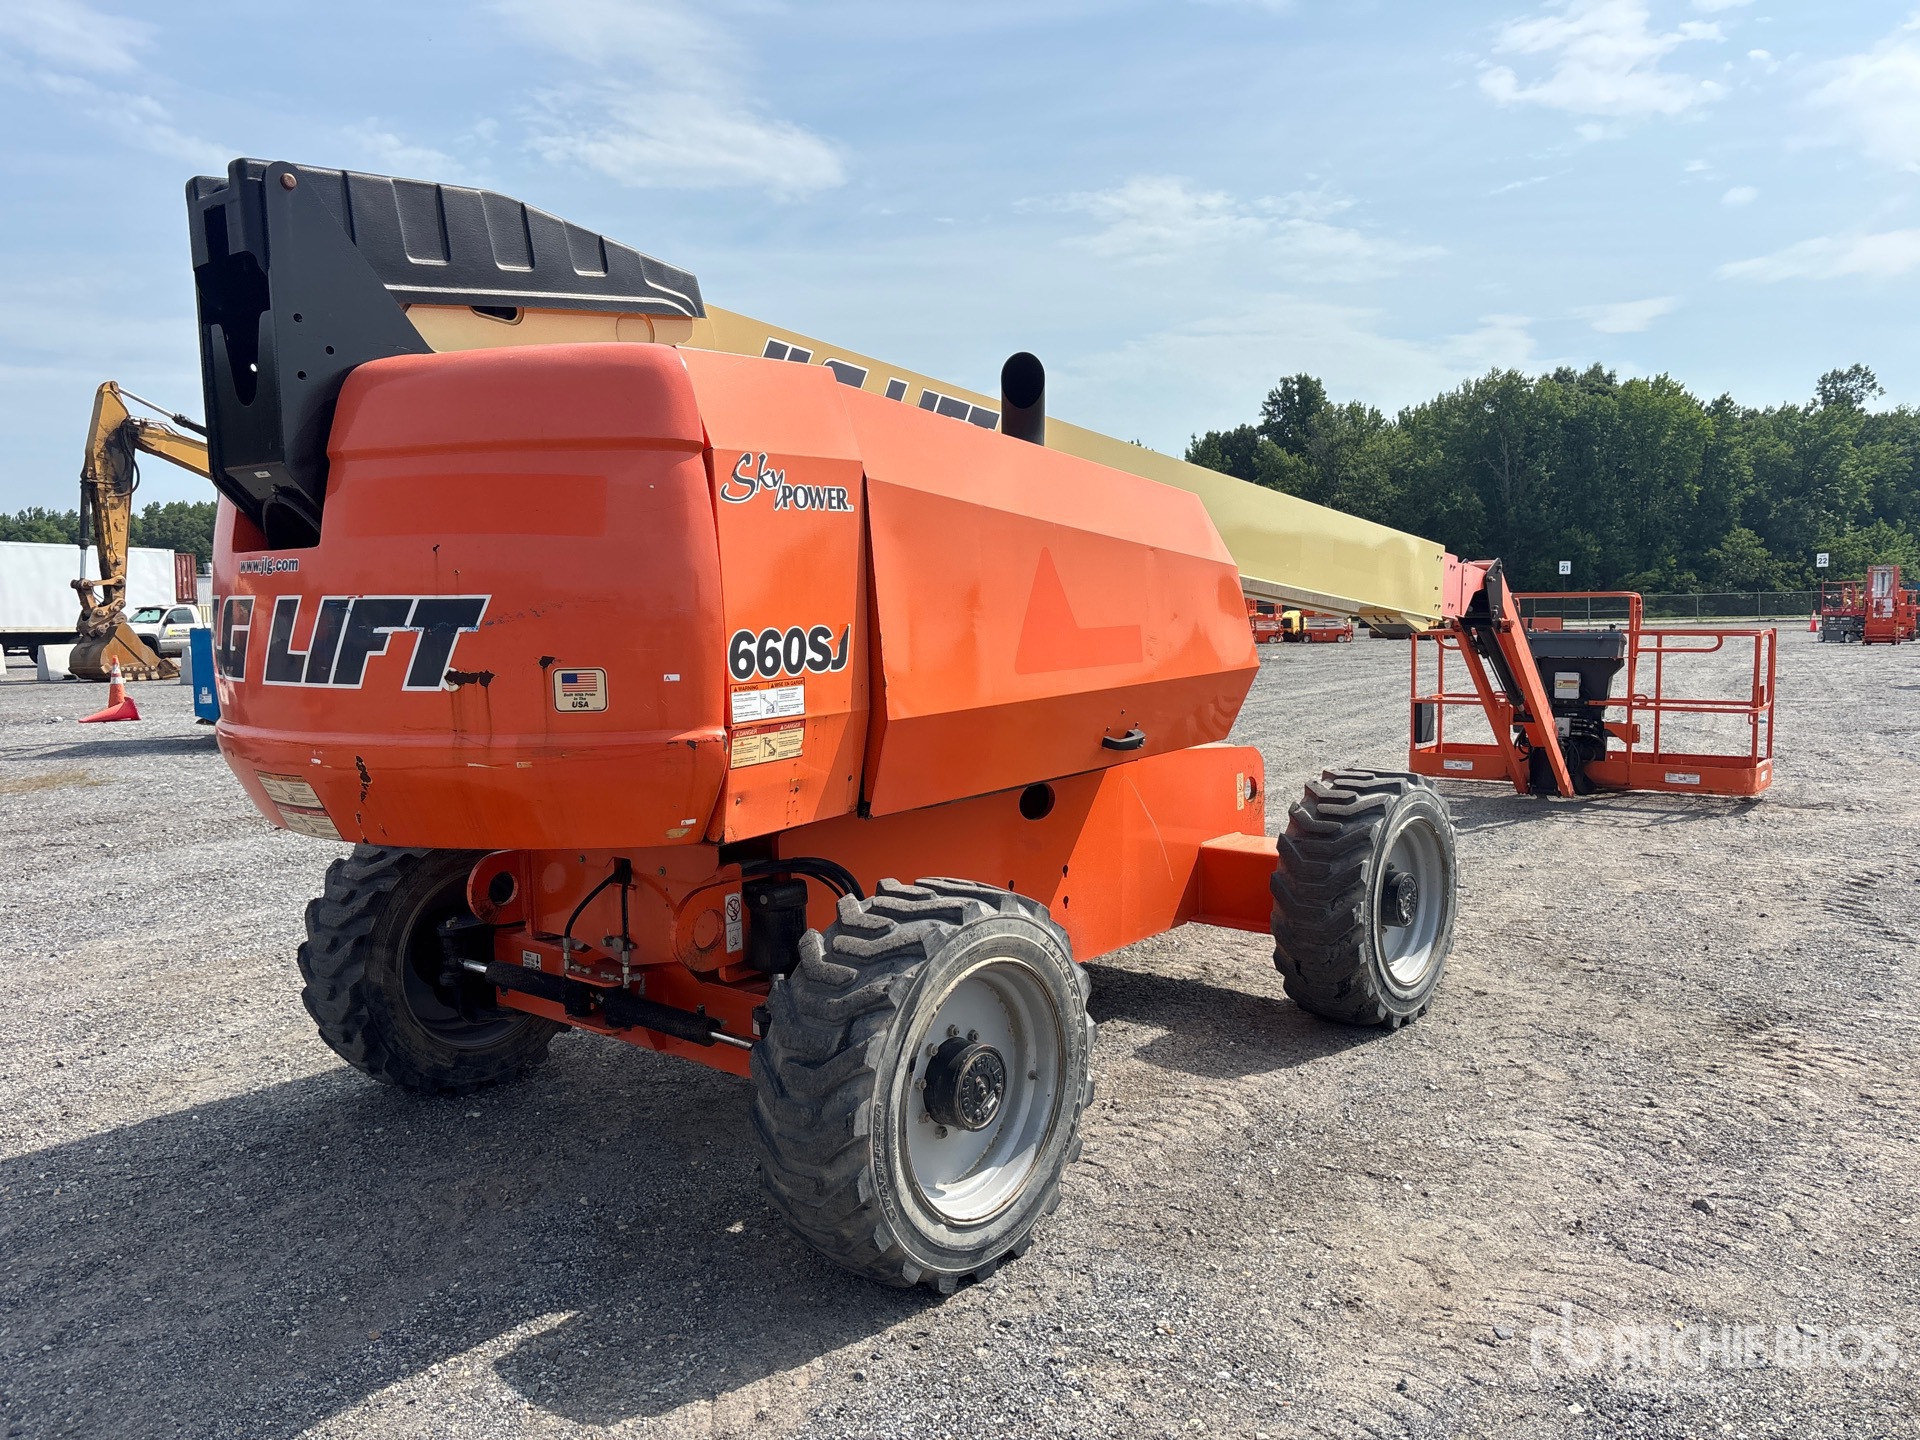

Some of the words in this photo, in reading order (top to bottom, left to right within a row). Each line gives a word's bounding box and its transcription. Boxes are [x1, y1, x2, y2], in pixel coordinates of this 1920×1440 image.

[240, 556, 299, 576] www.jlg.com
[262, 594, 492, 692] LIFT
[728, 624, 851, 681] 660SJ
[740, 729, 758, 737] DANGER
[783, 722, 801, 730] DANGER
